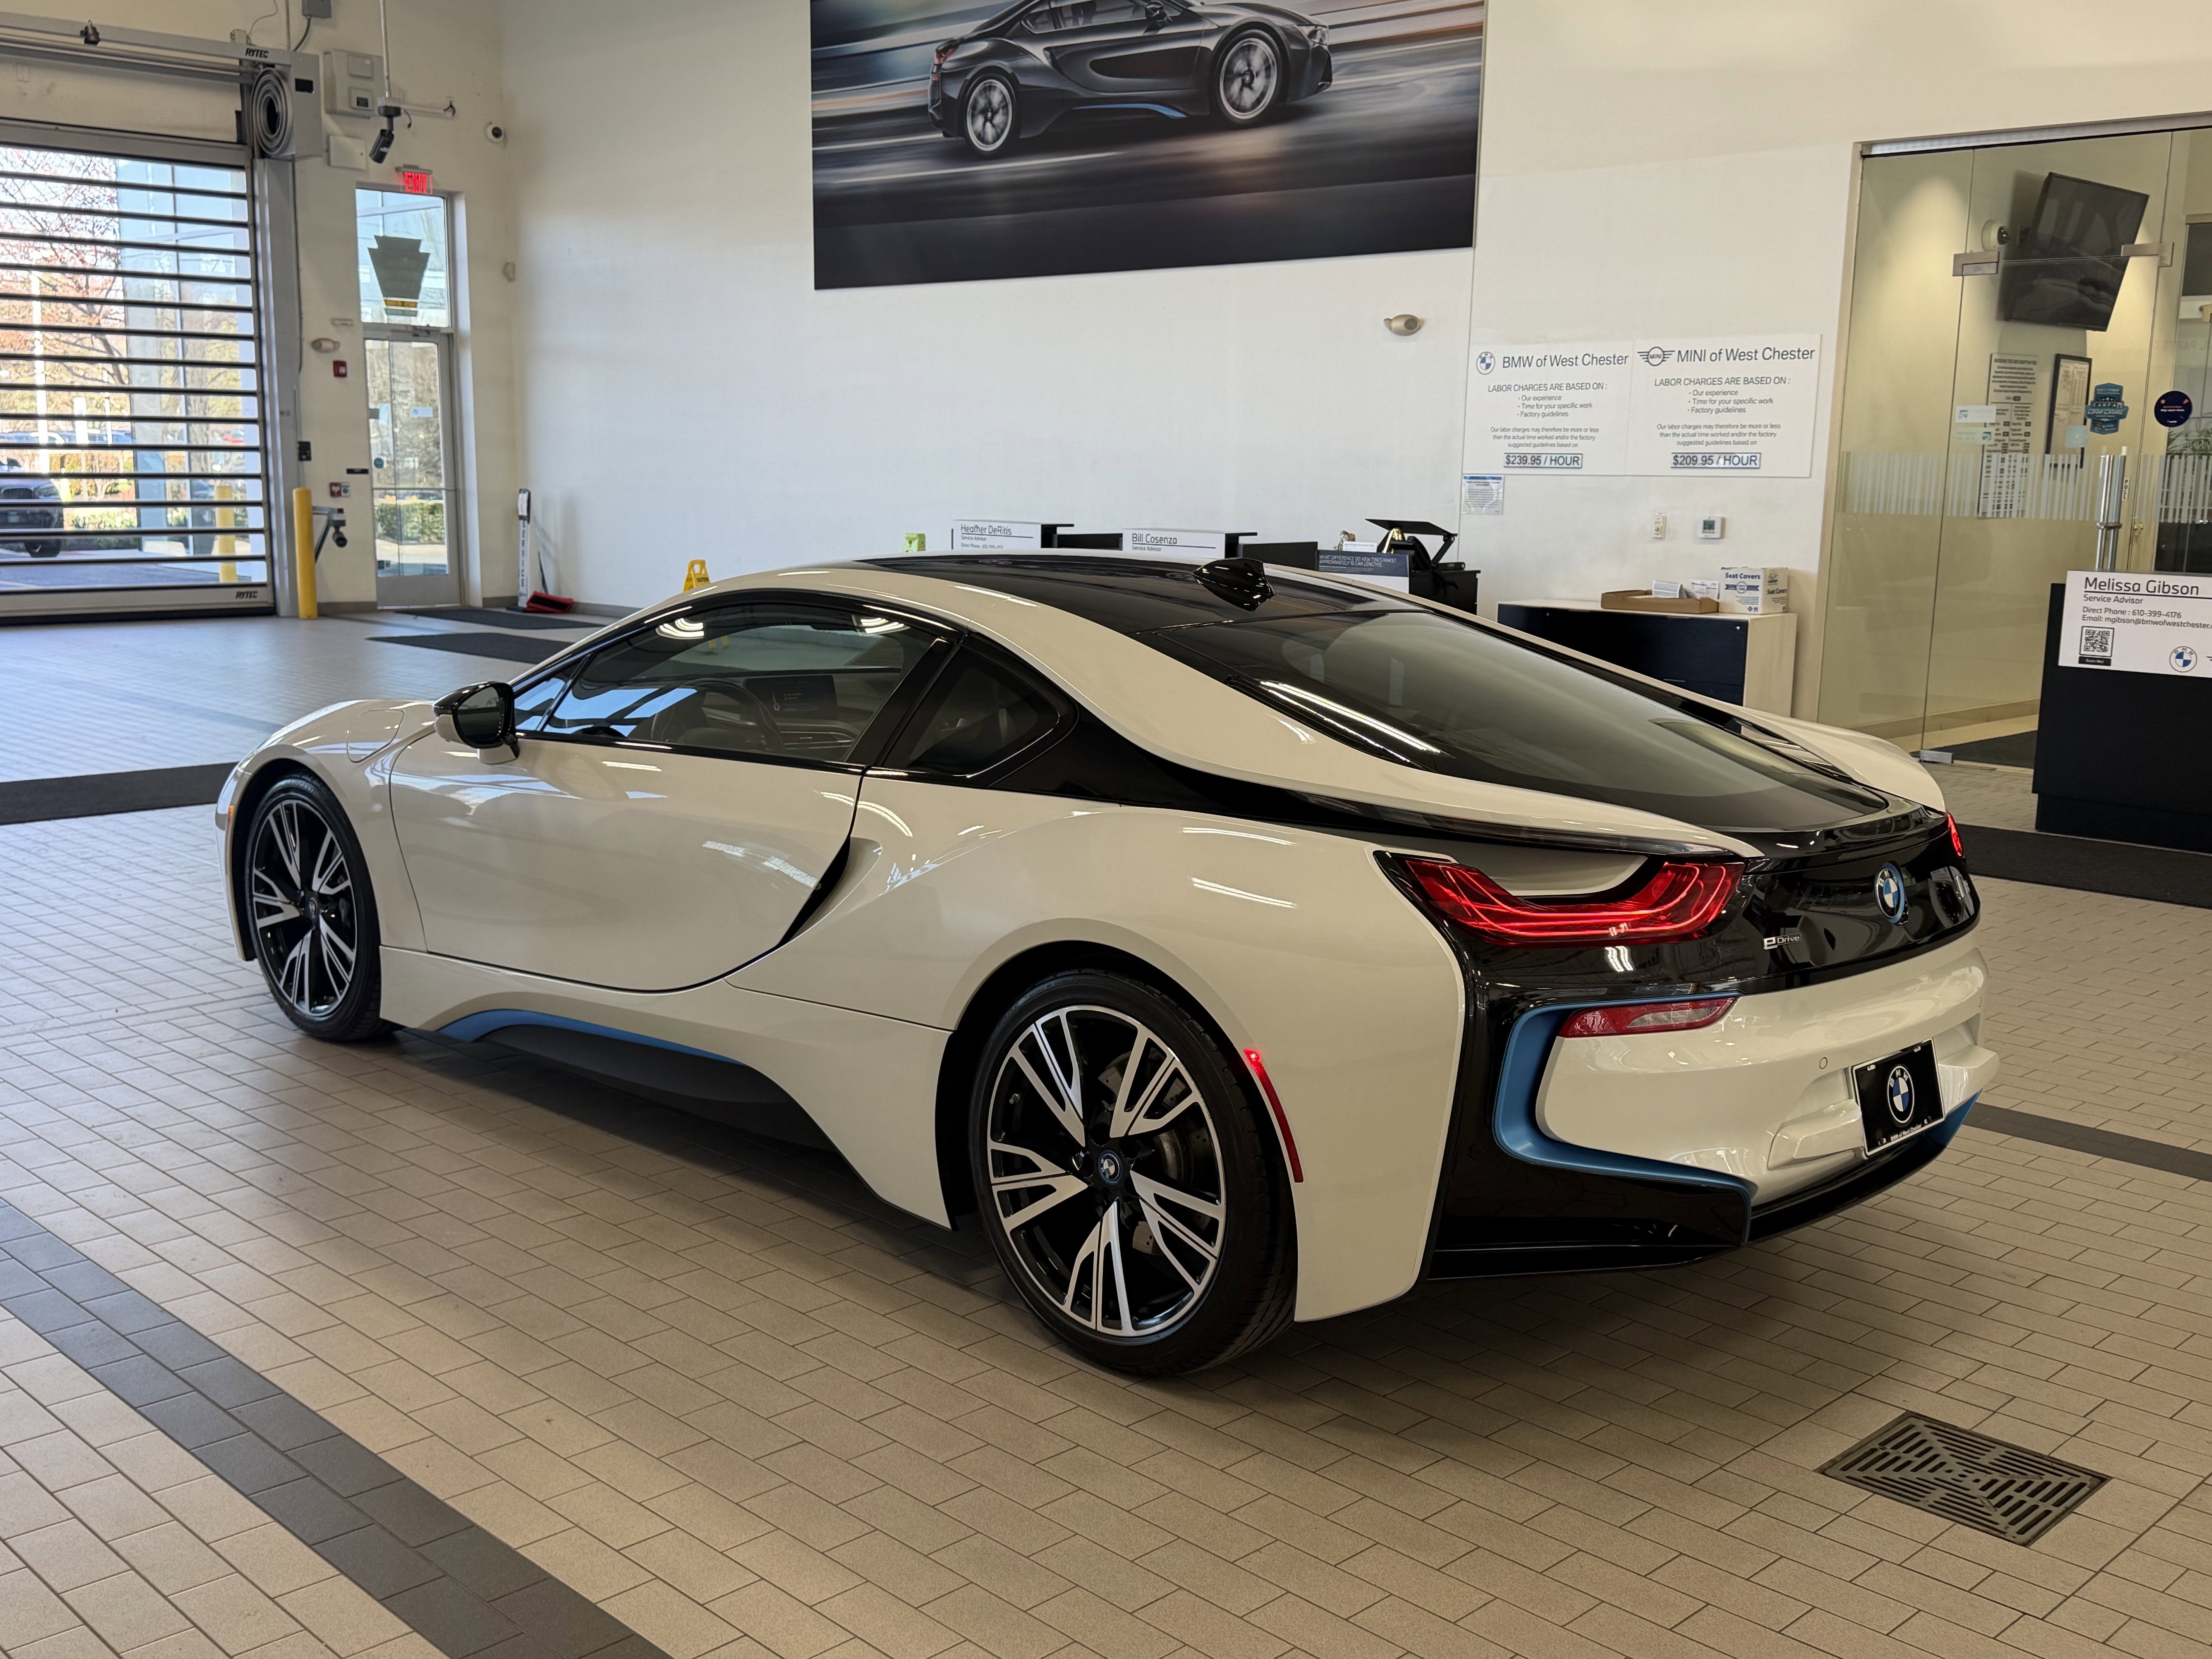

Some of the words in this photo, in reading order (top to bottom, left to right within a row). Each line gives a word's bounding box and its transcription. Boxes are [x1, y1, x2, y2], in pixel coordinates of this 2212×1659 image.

[246, 48, 269, 58] RYTEC
[405, 172, 428, 194] EXIT
[1677, 349, 1706, 362] MINI
[1709, 349, 1723, 362] of
[1725, 349, 1758, 361] West
[1762, 347, 1815, 361] Chester
[1503, 356, 1534, 368] BMW
[1536, 355, 1547, 367] of
[1549, 355, 1578, 366] West
[1582, 354, 1629, 366] Chester
[1654, 378, 1681, 386] LABOR
[1733, 398, 1757, 406] specific
[1505, 455, 1541, 465] $239.95
[1549, 456, 1580, 466] HOUR
[1673, 455, 1714, 466] $209.95
[1724, 455, 1757, 465] HOUR
[961, 524, 987, 534] Heather
[988, 526, 1012, 535] DeRitis
[1132, 533, 1143, 542] Bill
[1146, 534, 1177, 544] Cosenza
[2084, 577, 2141, 592] Melissa
[2146, 580, 2199, 595] Gibson
[2083, 594, 2111, 602] Service
[2113, 596, 2143, 604] Advisor
[2132, 610, 2182, 618] 610-399-4176
[2105, 617, 2212, 629] mgibson@bmwofwestchester.
[1890, 1069, 1908, 1088] BMW
